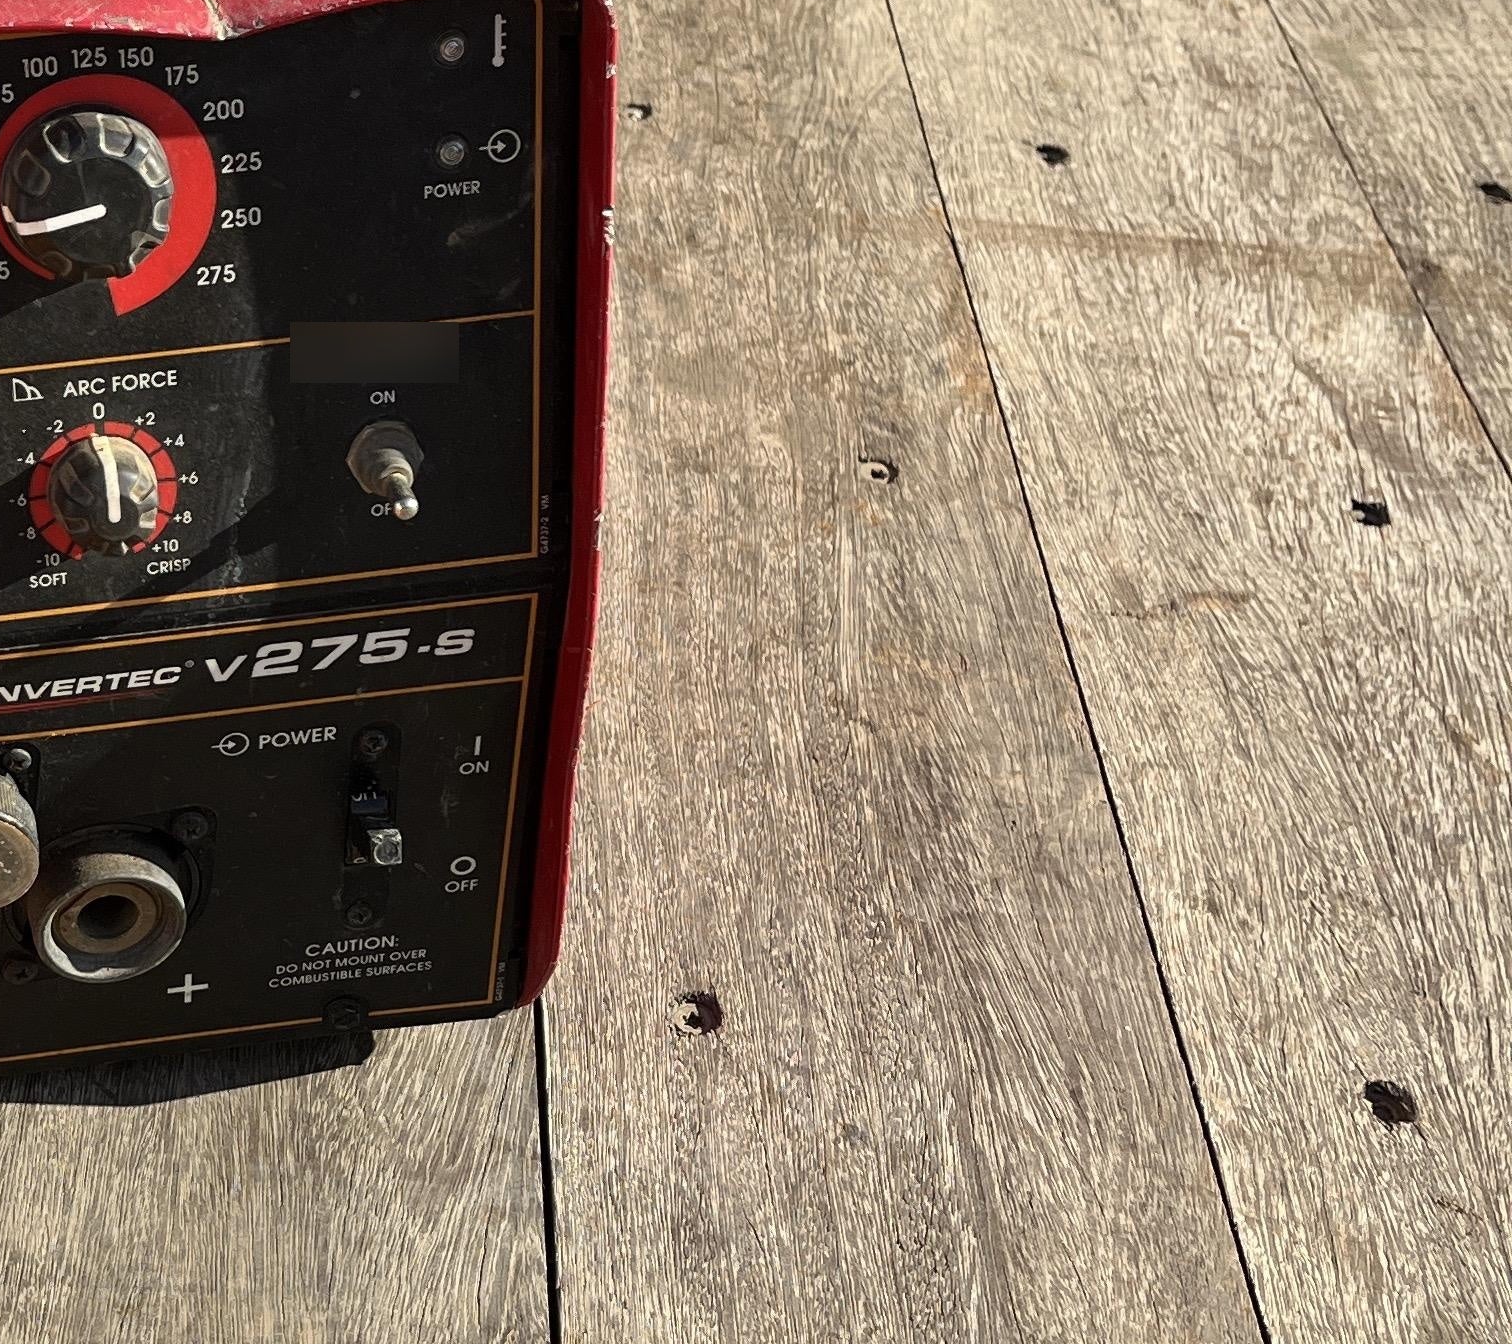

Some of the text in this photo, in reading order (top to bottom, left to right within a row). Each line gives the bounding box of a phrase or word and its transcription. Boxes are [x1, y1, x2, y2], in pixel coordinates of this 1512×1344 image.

[71, 46, 107, 69] 125
[118, 46, 155, 68] 150
[22, 56, 58, 78] 100
[165, 64, 200, 86] 175
[202, 99, 245, 122] 200
[221, 151, 263, 174] 225
[422, 180, 481, 200] POWER
[220, 206, 262, 229] 250
[196, 263, 236, 286] 275
[63, 369, 178, 398] ARC FORCE
[369, 389, 397, 406] ON
[92, 402, 105, 420] 0
[134, 411, 156, 427] +2
[45, 419, 64, 434] -2
[163, 433, 185, 448] +4
[16, 451, 35, 465] -4
[179, 471, 199, 486] +6
[9, 492, 27, 506] -6
[173, 510, 193, 525] +8
[18, 526, 37, 540] -8
[151, 538, 179, 554] +10
[37, 553, 61, 567] -10
[146, 557, 192, 576] CRISP
[29, 571, 68, 589] SOFT
[258, 726, 337, 751] POWER
[459, 760, 489, 775] ON
[444, 878, 479, 893] OFF
[305, 934, 399, 957] CAUTION:
[276, 948, 427, 975] DO NOT MOUNT OVER
[268, 960, 433, 989] COMBUSTIBLE SURFACES
